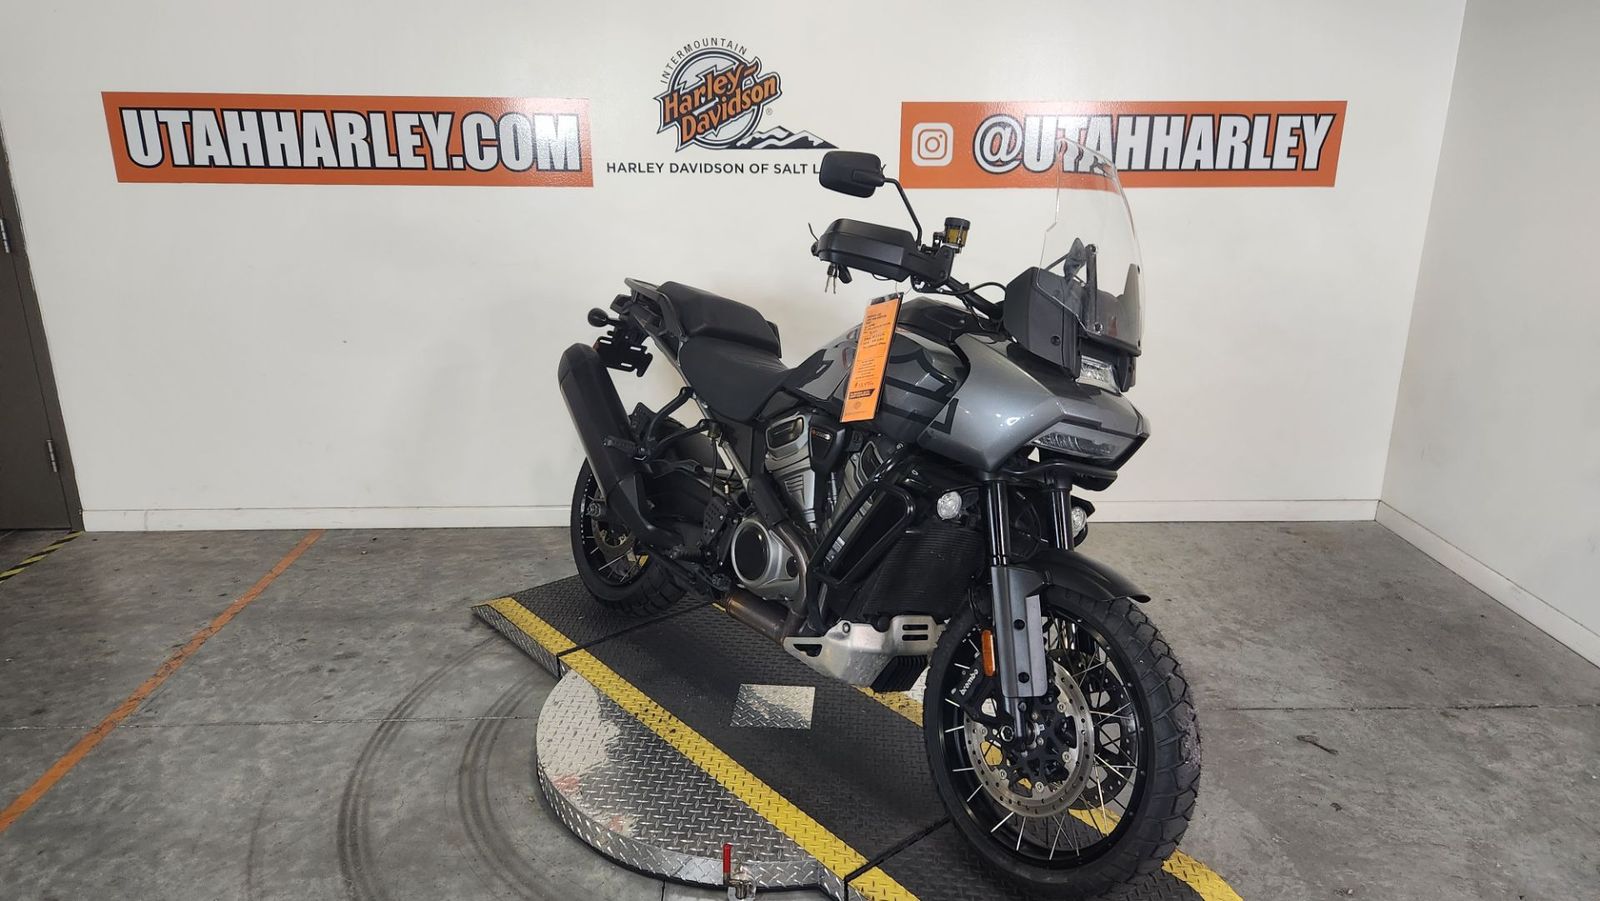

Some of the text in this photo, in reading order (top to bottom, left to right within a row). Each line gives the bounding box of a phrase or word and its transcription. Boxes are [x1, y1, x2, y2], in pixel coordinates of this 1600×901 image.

[660, 37, 748, 84] INTERMOUNTAIN
[681, 74, 778, 143] Davidson
[119, 106, 583, 172] UTAHHARLEY.COM
[972, 113, 1338, 175] @UTAHHARLEY
[607, 162, 665, 173] HARLEY
[669, 162, 745, 174] DAVIDSON
[750, 162, 769, 174] OF
[774, 163, 808, 174] SALT
[959, 669, 979, 696] brembo
